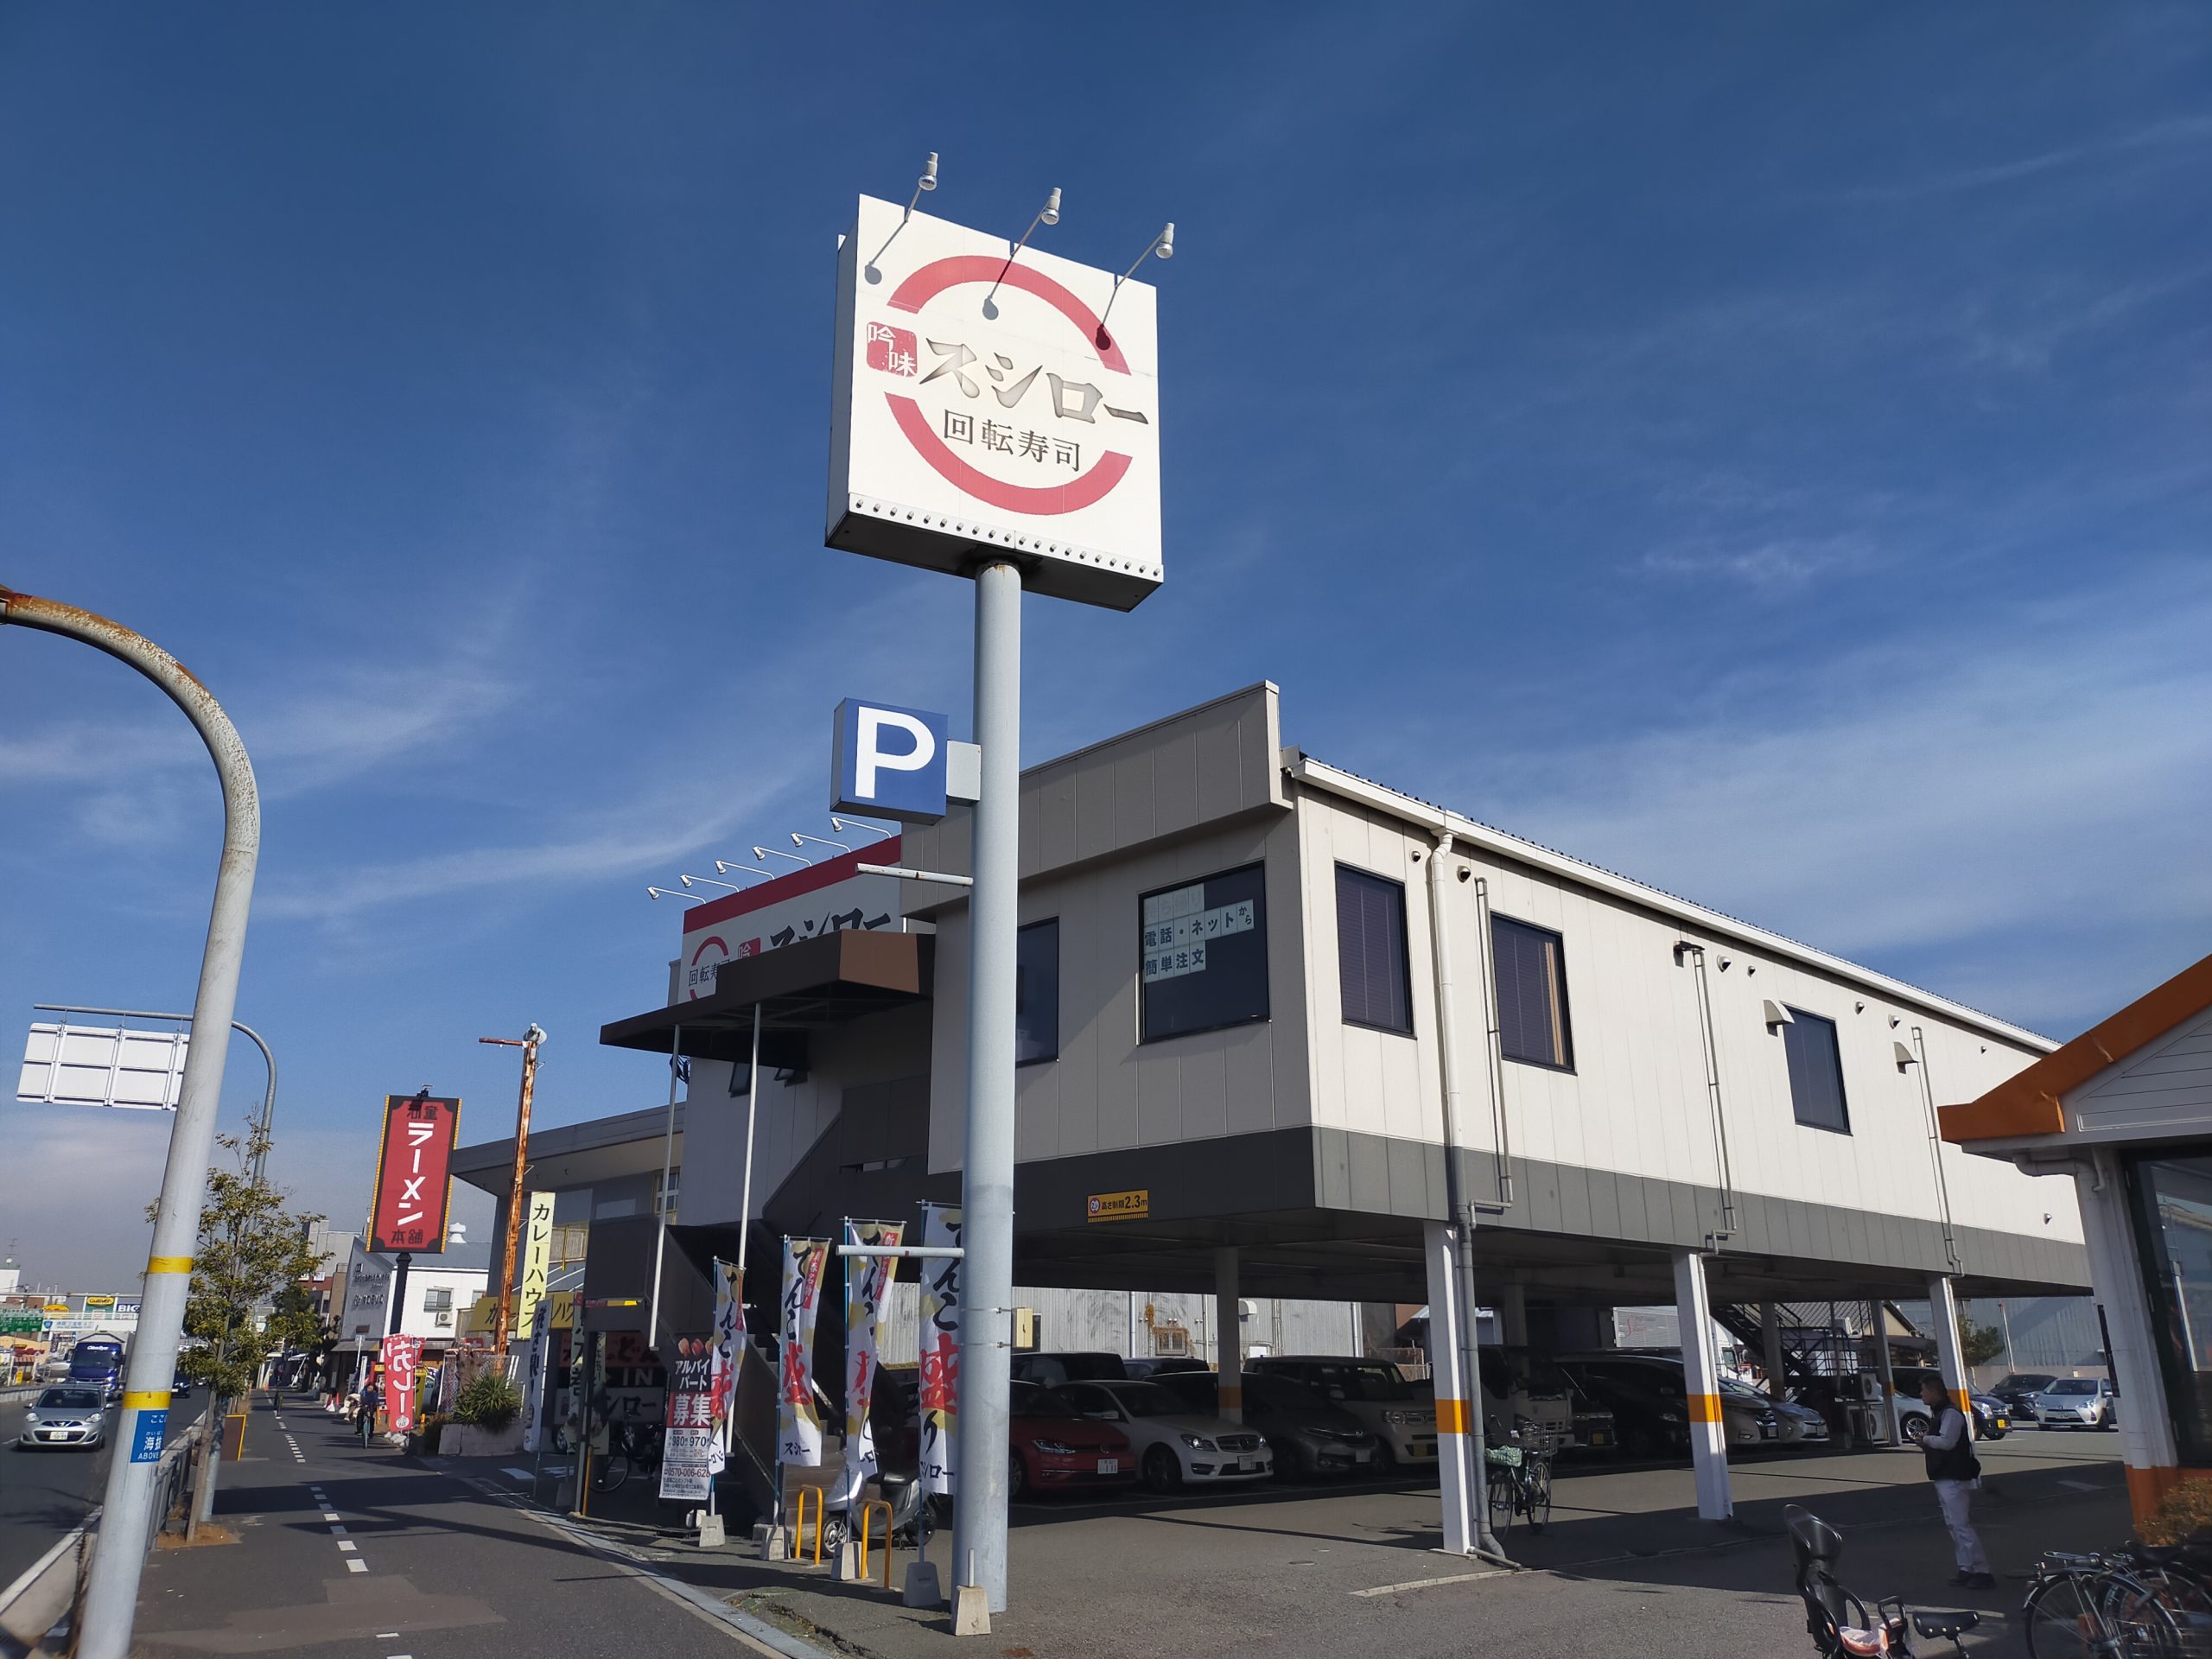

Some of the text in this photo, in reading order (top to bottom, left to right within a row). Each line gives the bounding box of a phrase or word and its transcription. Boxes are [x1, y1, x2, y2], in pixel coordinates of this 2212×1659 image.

[867, 324, 918, 378] 吟味
[919, 337, 1148, 425] スシロー
[944, 409, 1080, 472] 回転寿司
[855, 706, 935, 798] P
[689, 959, 730, 987] 回転寿
[1146, 948, 1204, 976] 簡単注文
[397, 1122, 434, 1225] ラーメン
[391, 1230, 423, 1244] 本舗
[521, 1204, 550, 1327] カレーハウス
[676, 1358, 709, 1375] アルバイ
[150, 1414, 167, 1423] ここ
[674, 1394, 711, 1426] 募集
